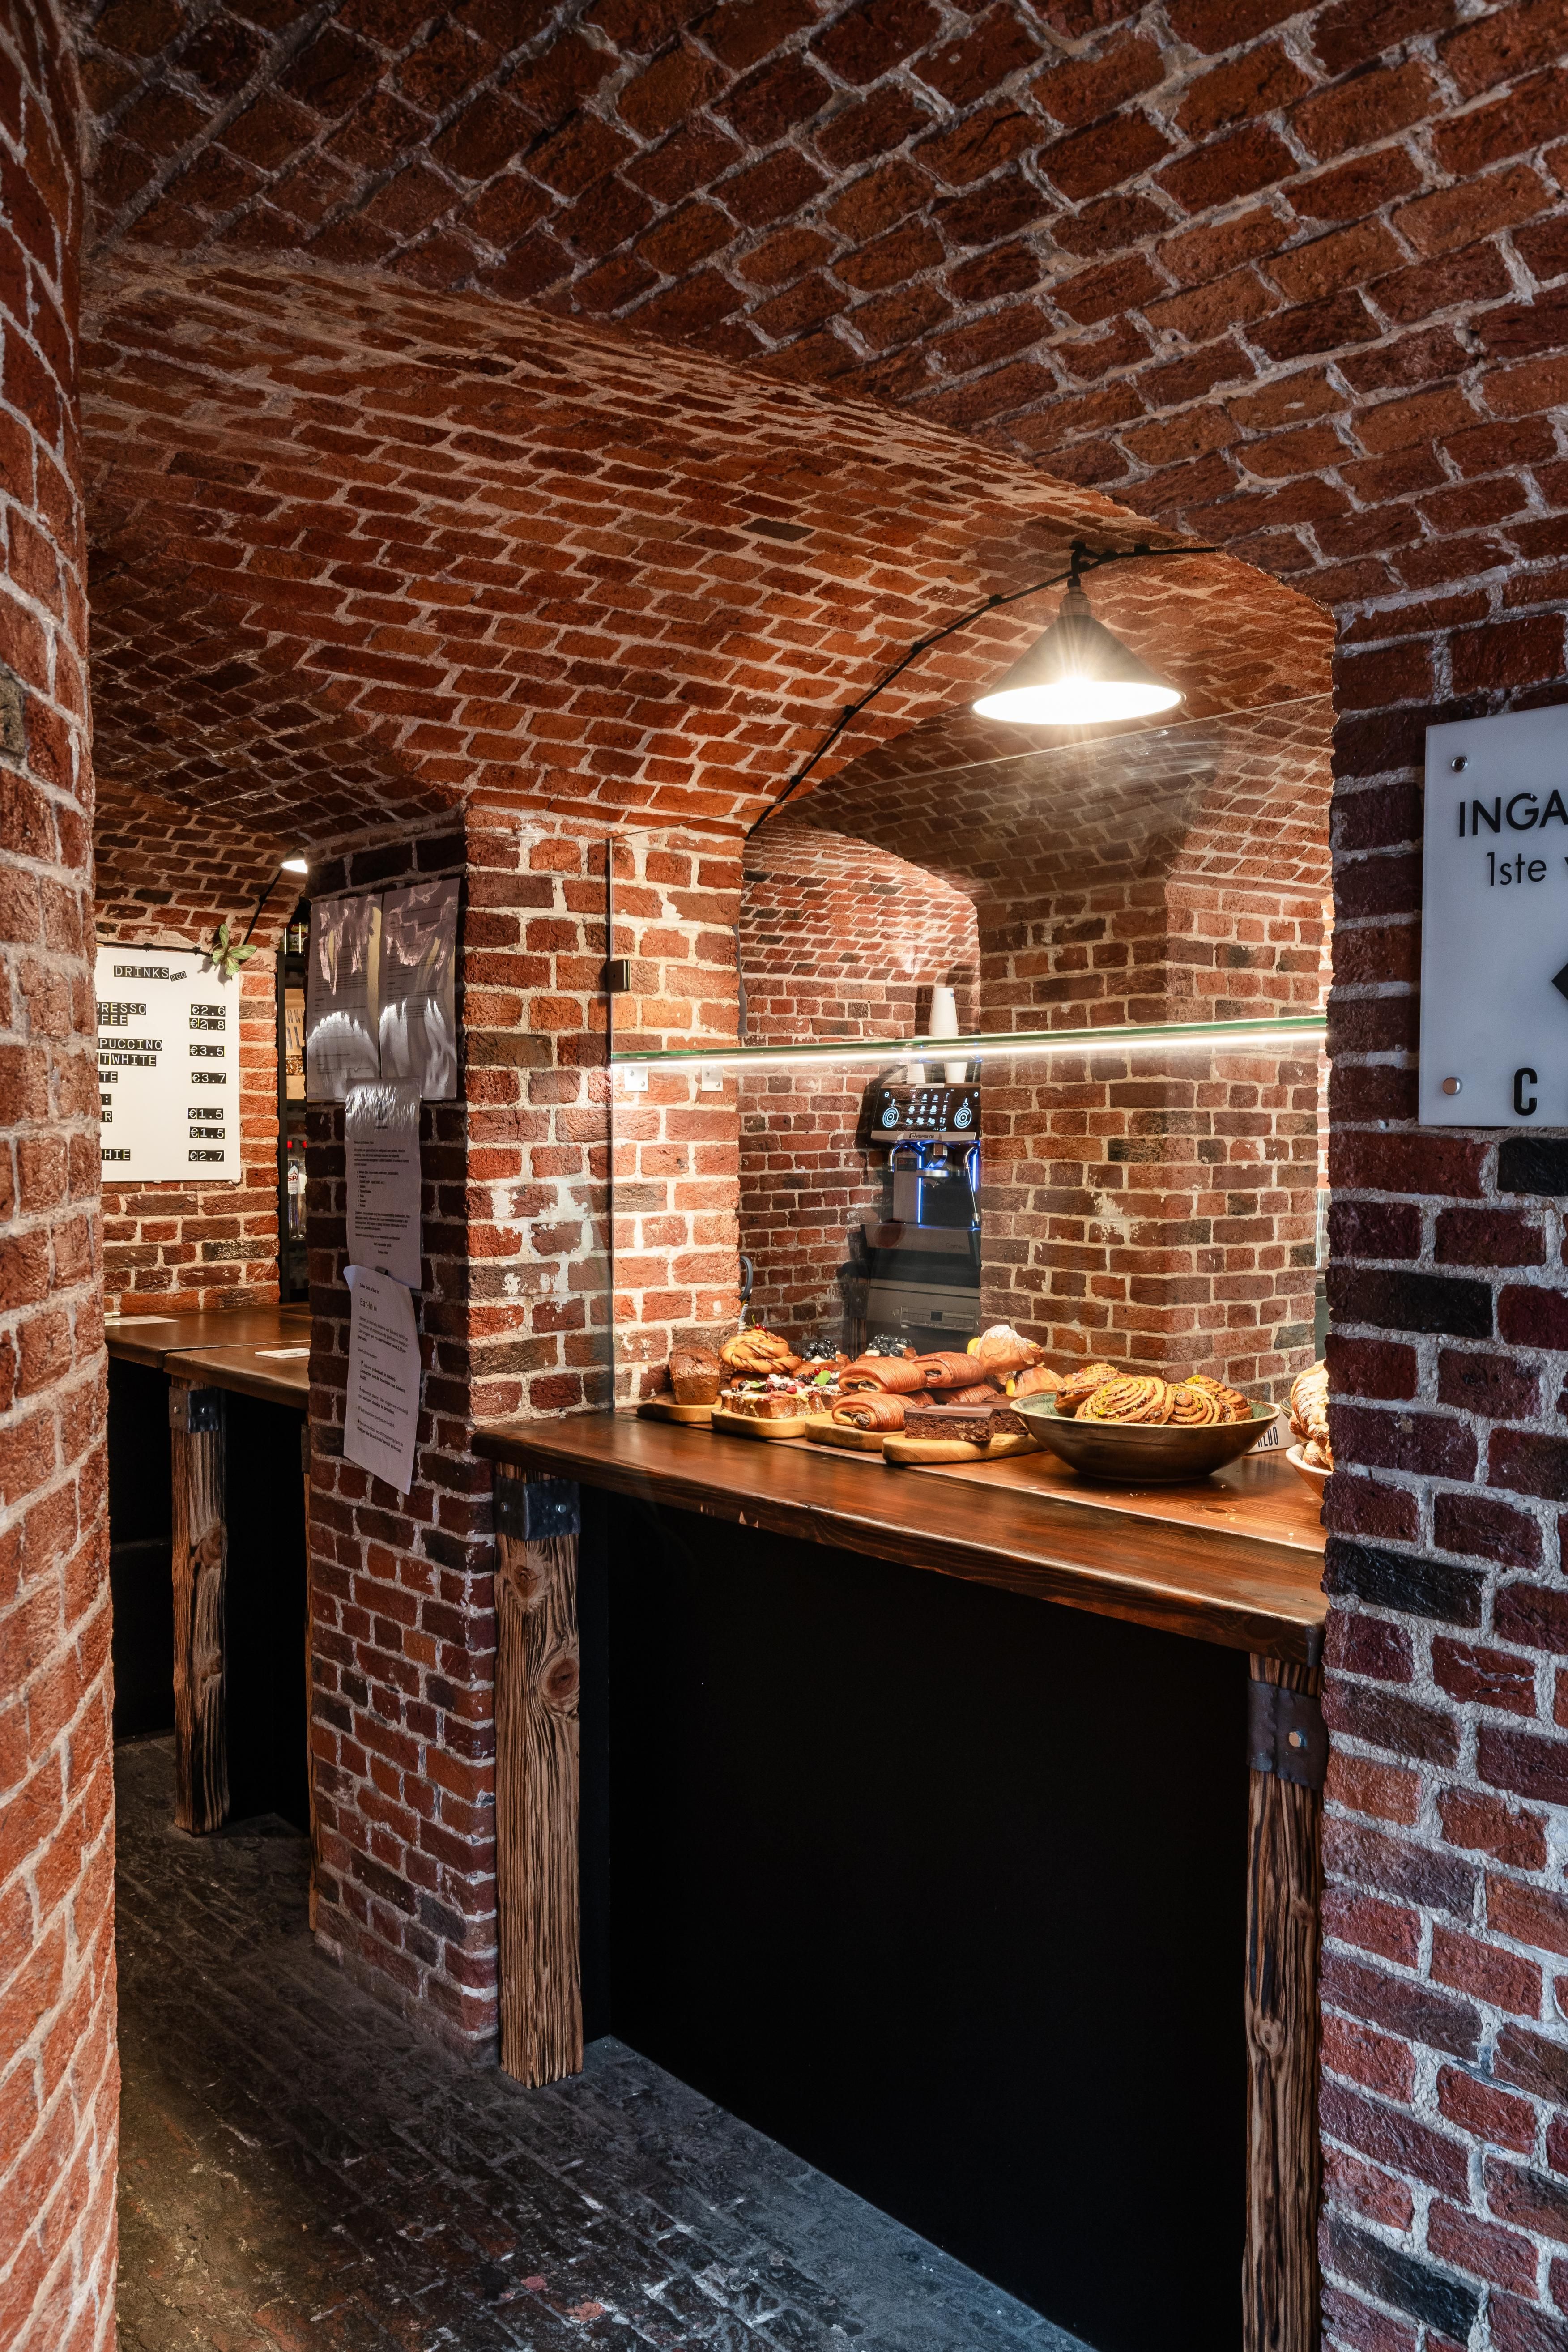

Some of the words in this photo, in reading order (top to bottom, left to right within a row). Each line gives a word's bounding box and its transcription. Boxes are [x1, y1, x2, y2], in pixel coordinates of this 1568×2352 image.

[1486, 852, 1547, 886] 1ste
[115, 966, 169, 978] DRINKS
[170, 972, 186, 981] 2GO
[192, 1005, 225, 1015] €2.6
[97, 1014, 127, 1025] FEE
[190, 1018, 225, 1030] €2.8
[100, 1038, 162, 1050] PUCCINO
[190, 1046, 224, 1056] €3.5
[98, 1072, 117, 1082] TE
[192, 1073, 225, 1083] €3.7
[1514, 1067, 1538, 1116] C
[189, 1109, 222, 1119] €1.5
[190, 1128, 224, 1138] €1.5
[189, 1151, 223, 1161] €2.7
[360, 1297, 373, 1310] Eat-In
